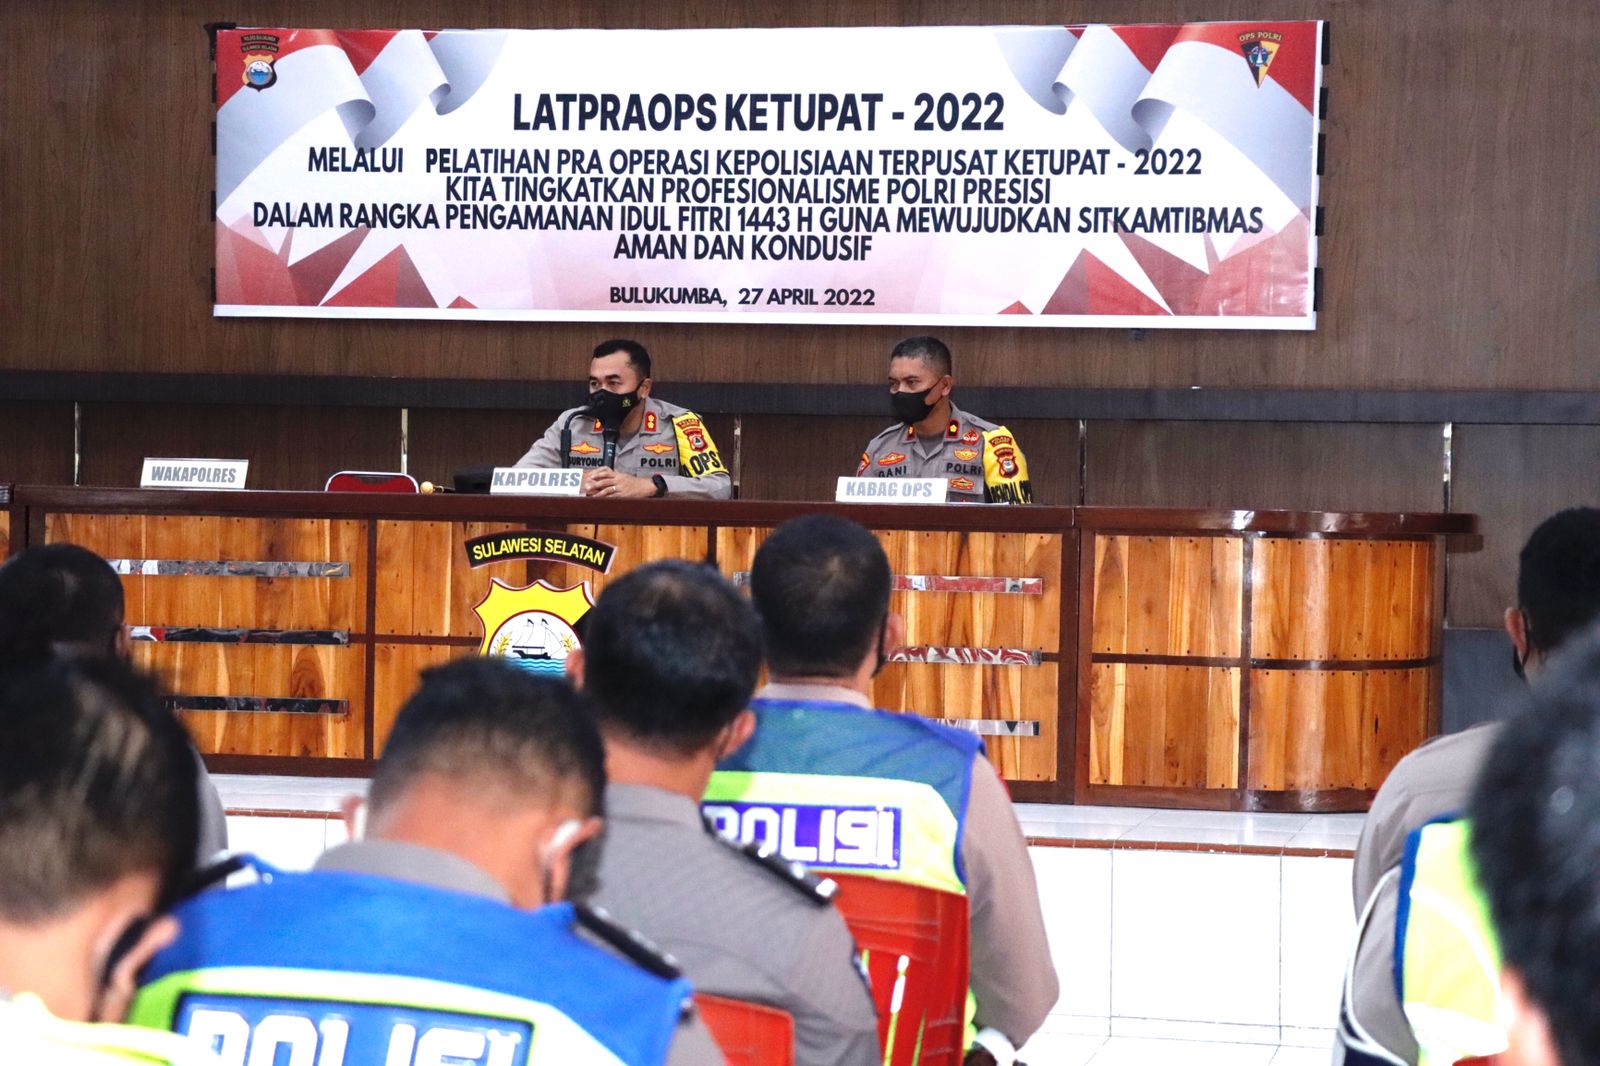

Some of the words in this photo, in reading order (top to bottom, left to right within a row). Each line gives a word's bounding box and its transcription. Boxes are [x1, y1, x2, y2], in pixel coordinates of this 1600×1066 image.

[1239, 32, 1256, 41] OPS
[1257, 31, 1282, 41] POLRI
[513, 93, 718, 132] LATPRAOPS
[725, 93, 884, 132] KETUPAT
[892, 111, 905, 120] -
[914, 92, 1005, 131] 2022
[308, 146, 404, 173] MELALUI
[426, 148, 550, 174] PELATIHAN
[557, 149, 604, 174] PRA
[609, 149, 709, 175] OPERASI
[716, 149, 873, 176] KEPOLISIAAN
[878, 149, 998, 176] TERPUSAT
[1004, 149, 1111, 176] KETUPAT
[1133, 148, 1202, 176] 2022
[445, 175, 497, 202] KITA
[501, 176, 655, 203] TINGKATKAN
[661, 177, 880, 205] PROFESIONALISME
[886, 177, 956, 205] POLRI
[962, 177, 1051, 205] PRESISI
[253, 201, 334, 228] DALAM
[339, 202, 440, 230] RANGKA
[445, 203, 614, 231] PENGAMANAN
[620, 205, 671, 232] IDUL
[677, 205, 731, 232] FITRI
[737, 205, 791, 233] 1443
[797, 206, 813, 232] H
[819, 206, 891, 233] GUNA
[895, 206, 1071, 233] MEWUJUDKAN
[1077, 206, 1264, 234] SITKAMTIBMAS
[613, 233, 687, 260] AMAN
[694, 234, 744, 260] DAN
[751, 234, 873, 261] KONDUSIF
[610, 286, 728, 308] BULUKUMBA,
[738, 287, 764, 305] 27
[766, 288, 819, 306] APRIL
[823, 288, 875, 306] 2022
[640, 457, 677, 468] POLRI
[946, 462, 983, 476] POLRI
[151, 465, 237, 483] WAKAPOLRES
[492, 471, 581, 488] KAPOLRES
[845, 481, 898, 497] KABAG
[901, 482, 933, 498] OPS
[472, 537, 542, 560] SULAWESI
[544, 539, 606, 566] SELATAN
